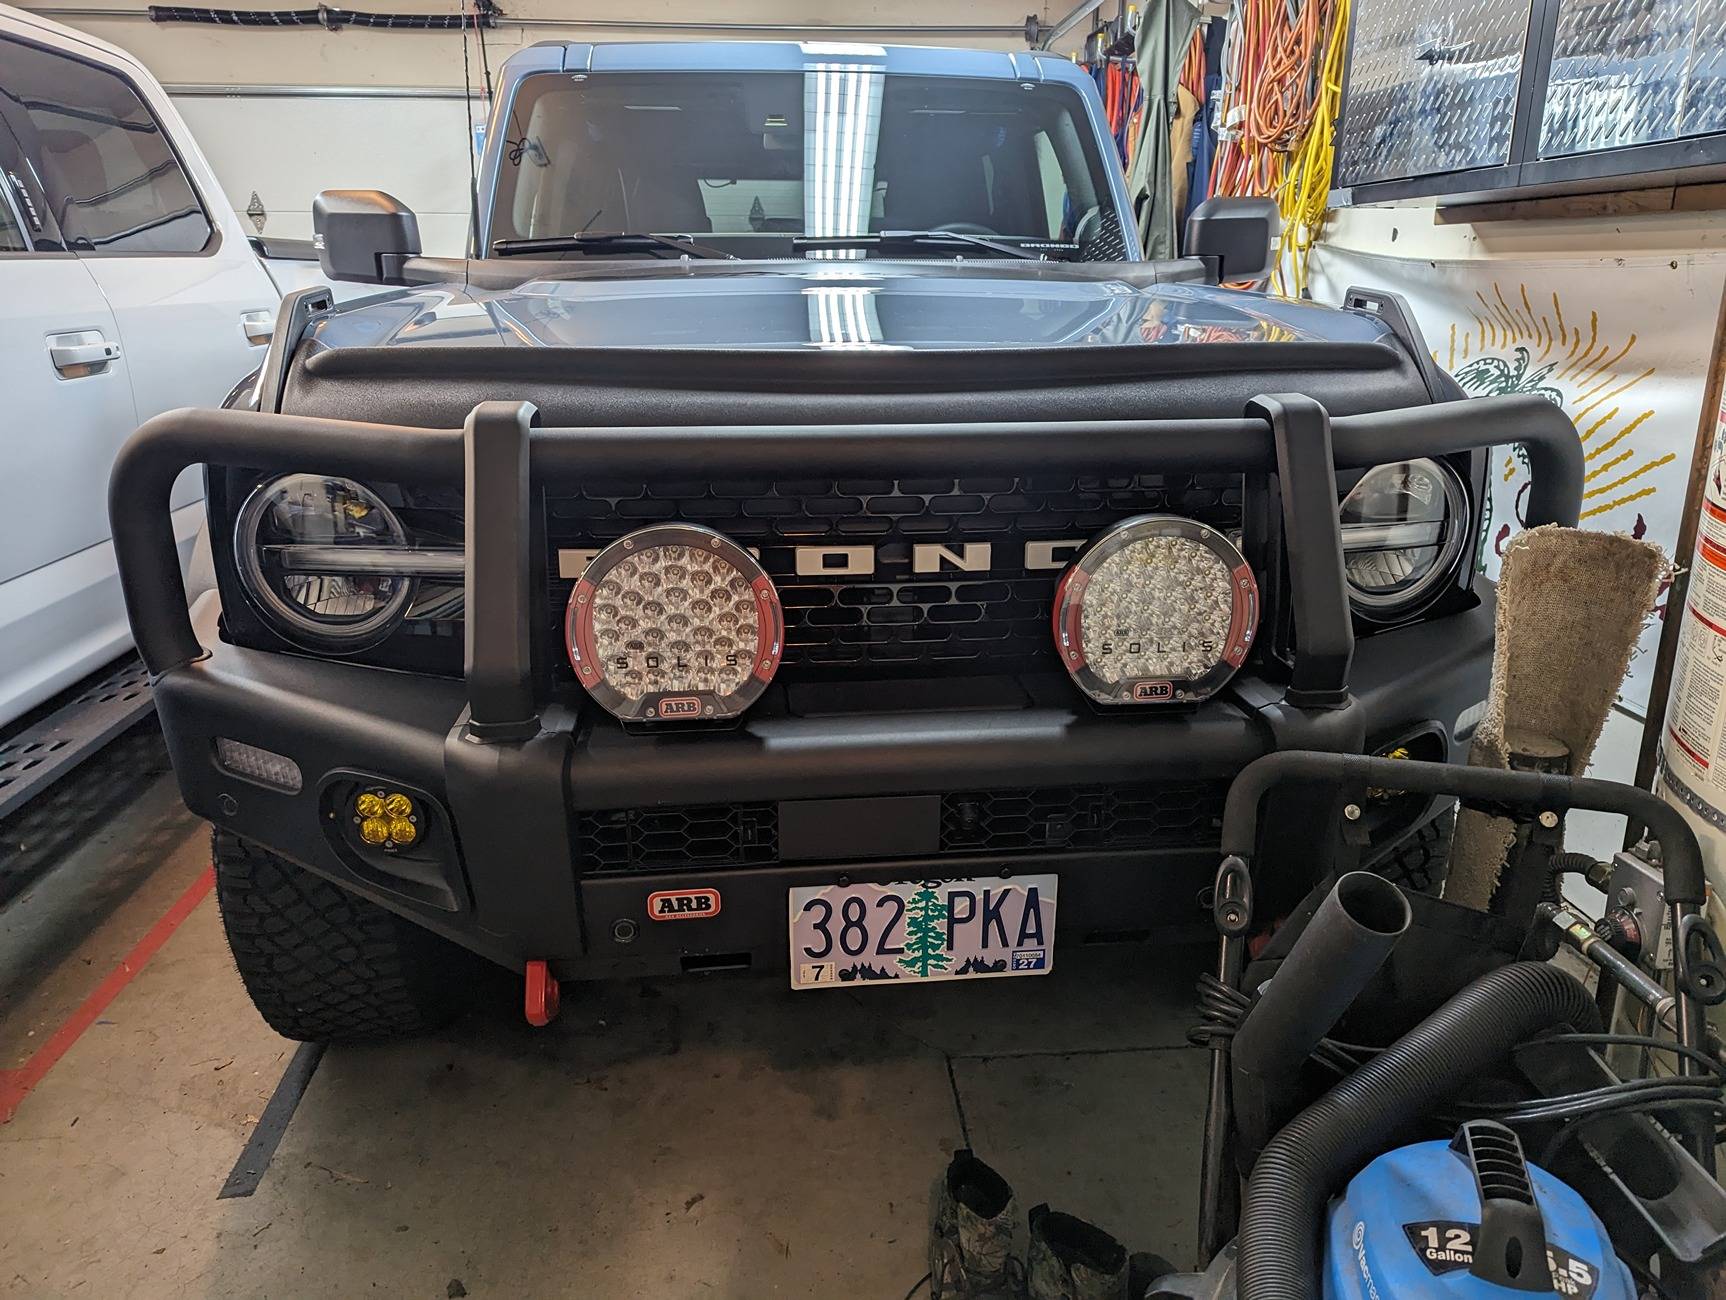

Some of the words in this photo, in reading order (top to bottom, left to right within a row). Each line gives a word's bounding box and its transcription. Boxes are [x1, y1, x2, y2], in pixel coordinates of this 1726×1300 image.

[1102, 640, 1213, 655] SOLIS
[616, 654, 737, 669] SOLIS
[1138, 685, 1169, 697] ARB
[664, 701, 697, 714] ARB
[658, 895, 713, 914] ARB
[802, 893, 906, 959] 382
[946, 887, 1046, 952] PKA
[1018, 958, 1037, 969] 27
[811, 964, 825, 982] 7
[1420, 1226, 1473, 1252] 12
[1426, 1248, 1473, 1264] Gallon
[1552, 1278, 1579, 1295] HP
